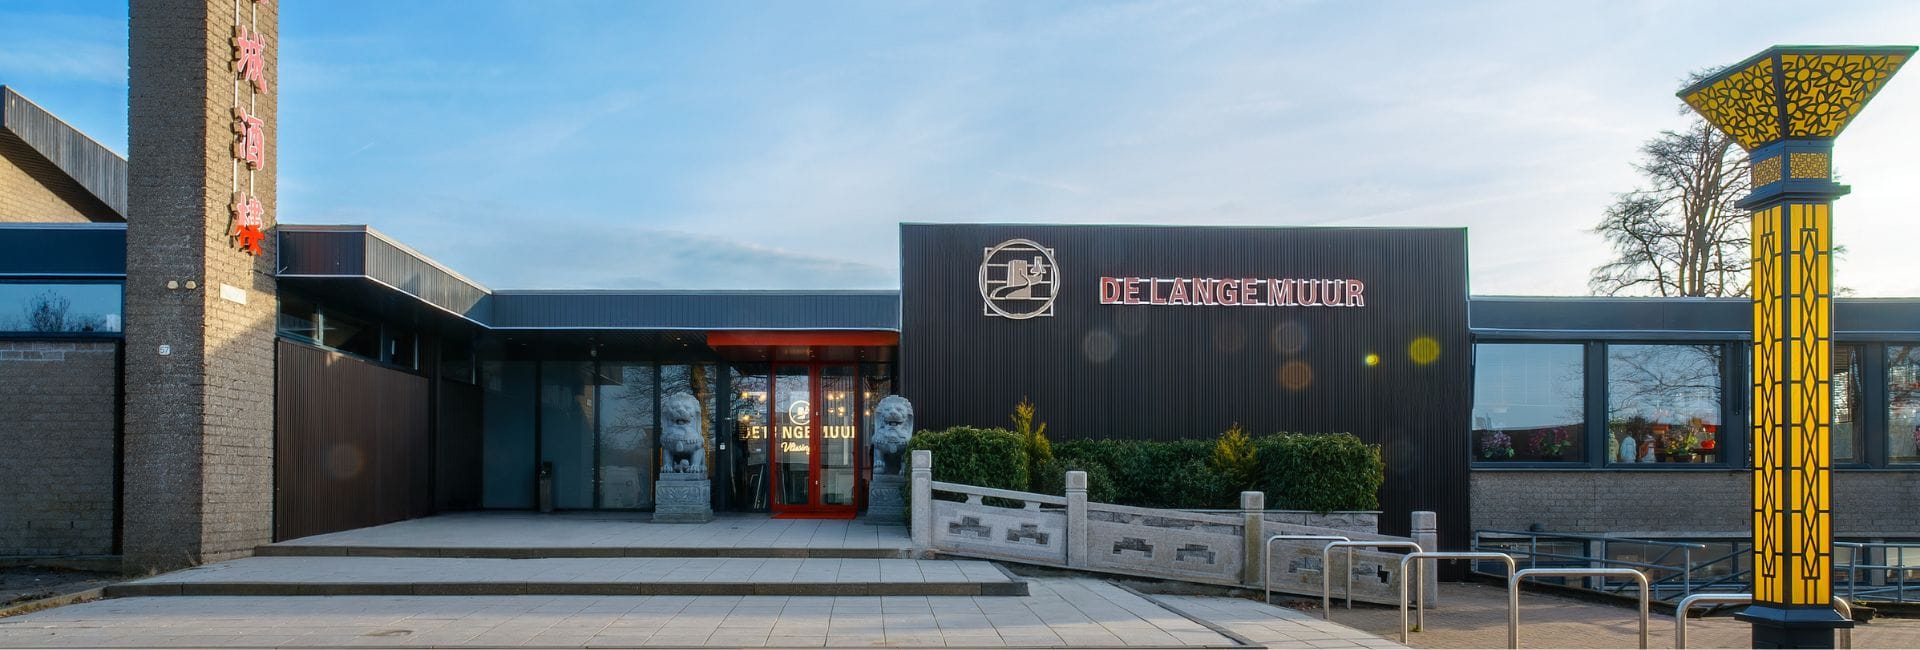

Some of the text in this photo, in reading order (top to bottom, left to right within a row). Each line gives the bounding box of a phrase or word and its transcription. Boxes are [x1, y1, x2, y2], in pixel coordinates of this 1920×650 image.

[236, 0, 269, 257] 城酒樓
[1099, 276, 1365, 307] DE LANGE MUUR
